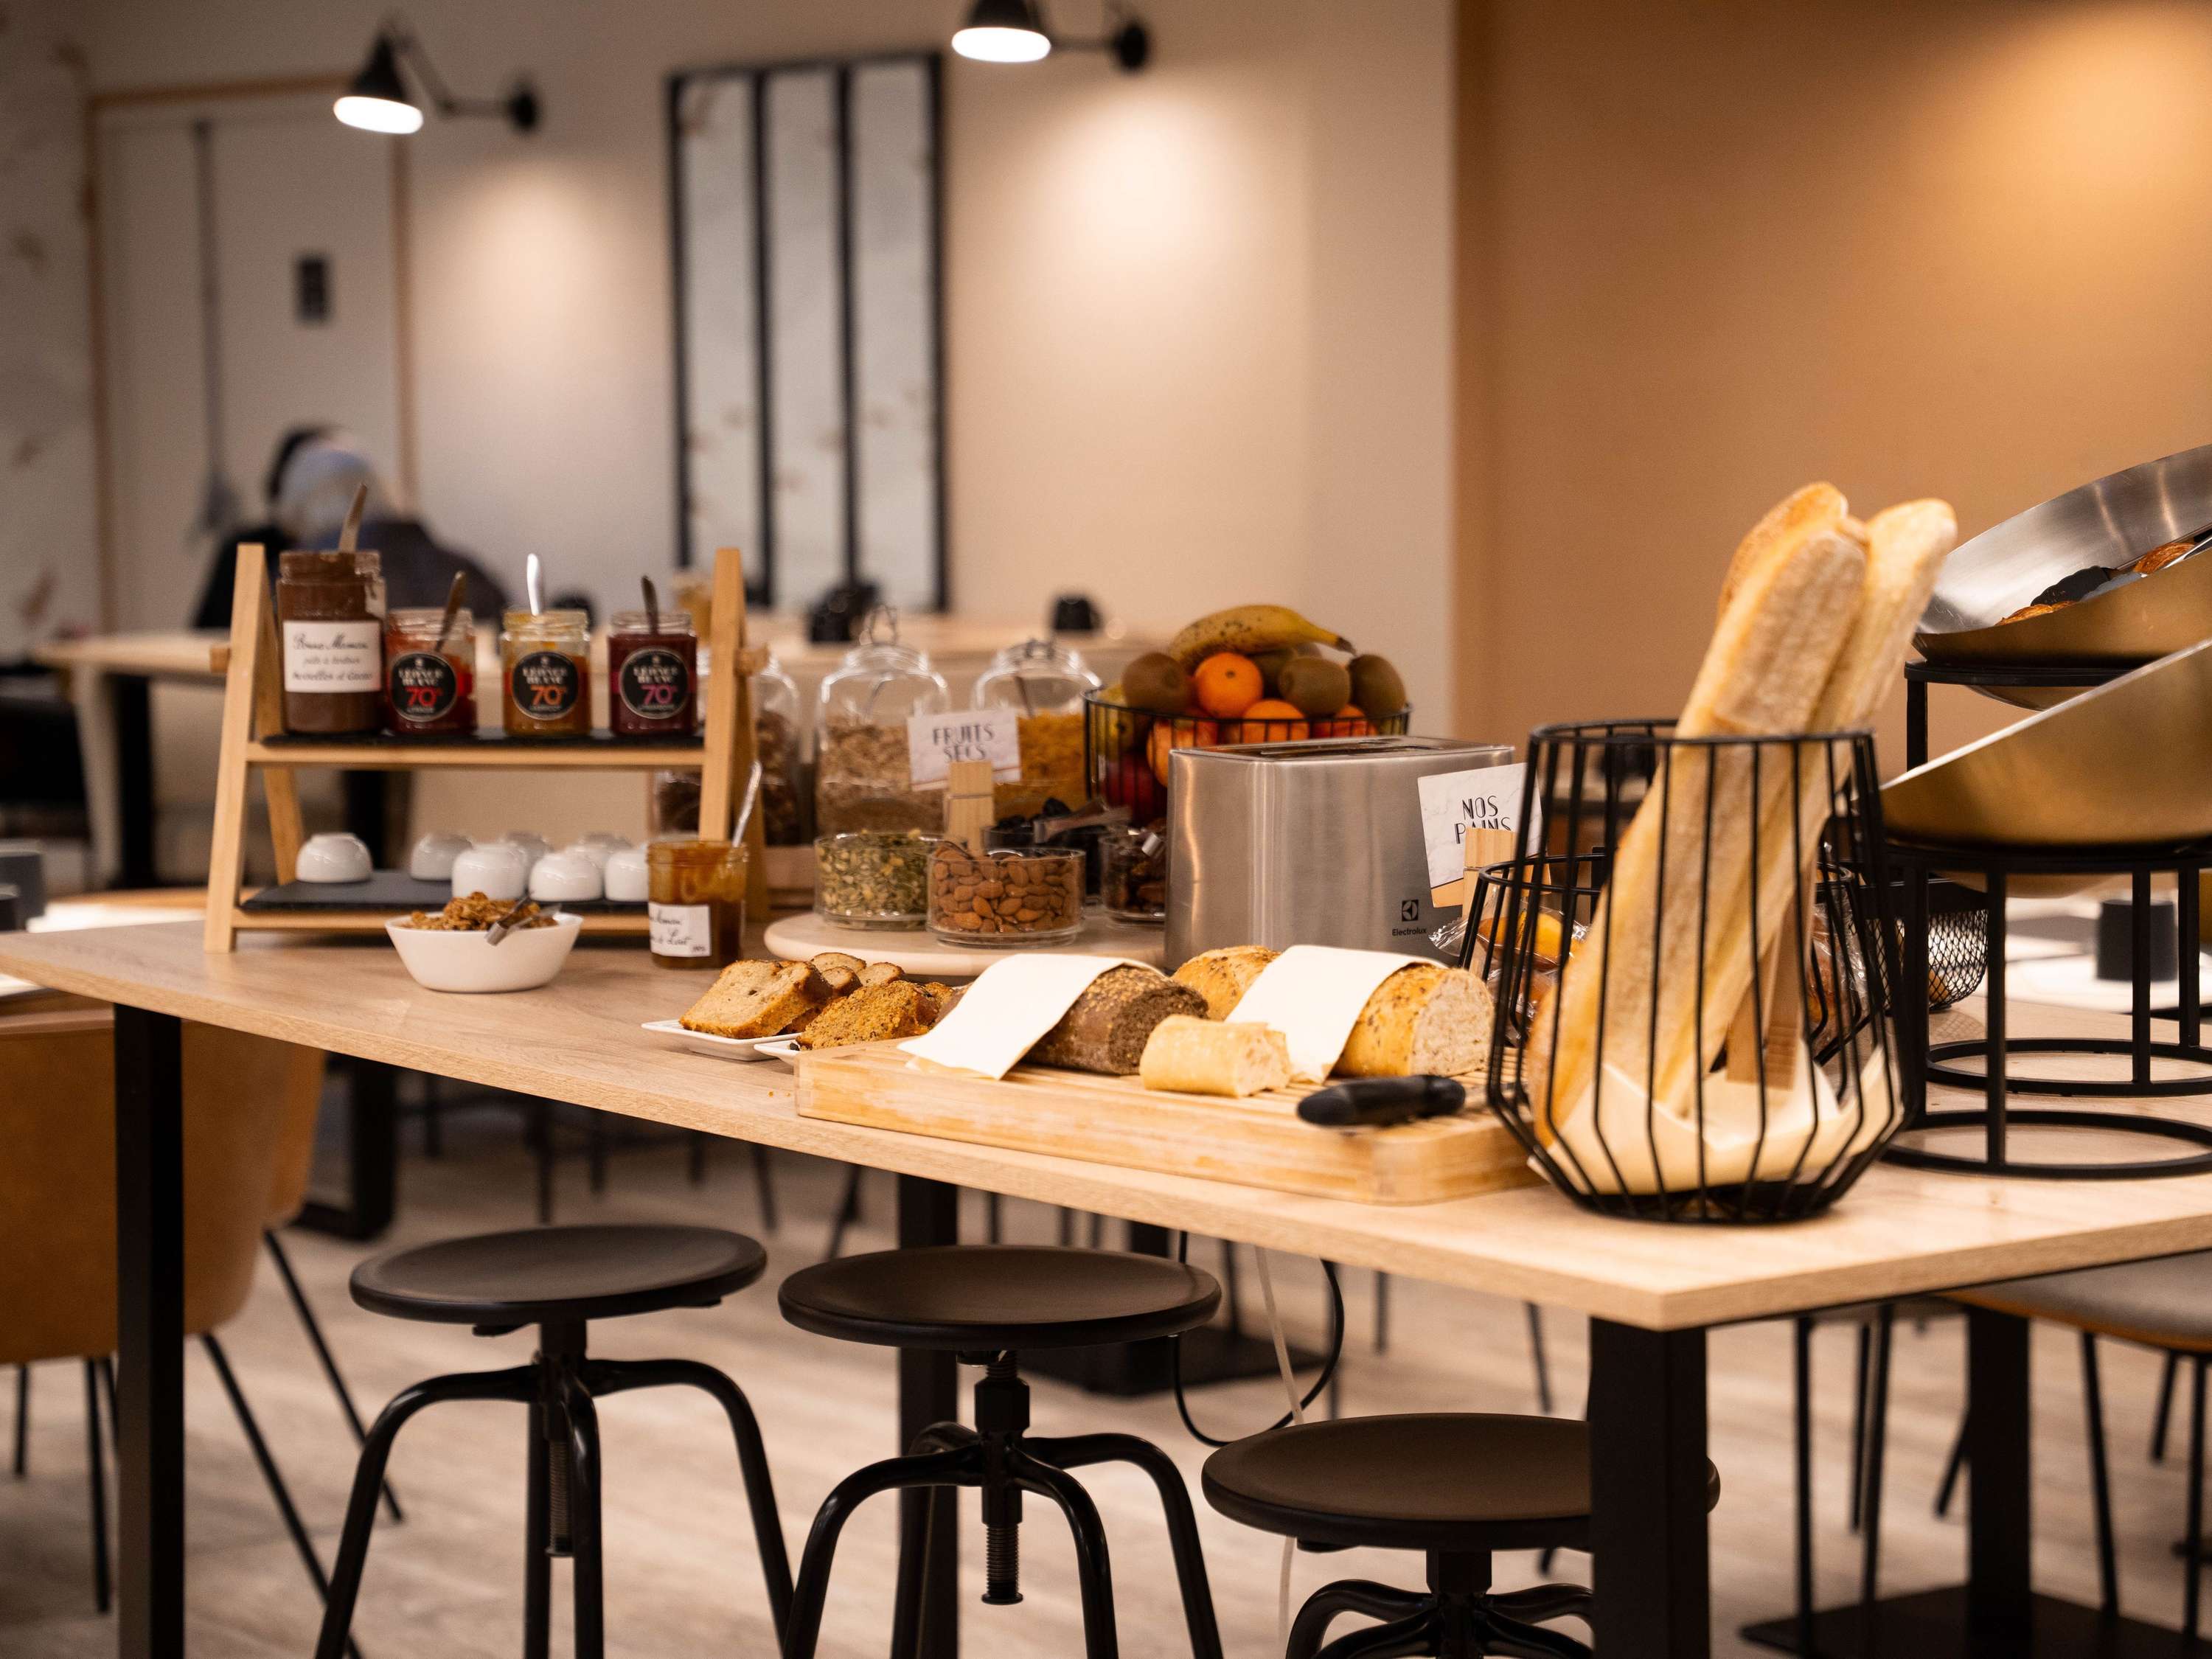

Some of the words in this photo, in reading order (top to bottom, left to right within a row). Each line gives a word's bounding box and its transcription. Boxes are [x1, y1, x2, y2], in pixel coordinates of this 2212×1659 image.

[933, 723, 994, 745] FRUITS
[944, 743, 986, 762] SECS
[1462, 796, 1498, 820] NOS
[1392, 927, 1427, 936] Electrolux
